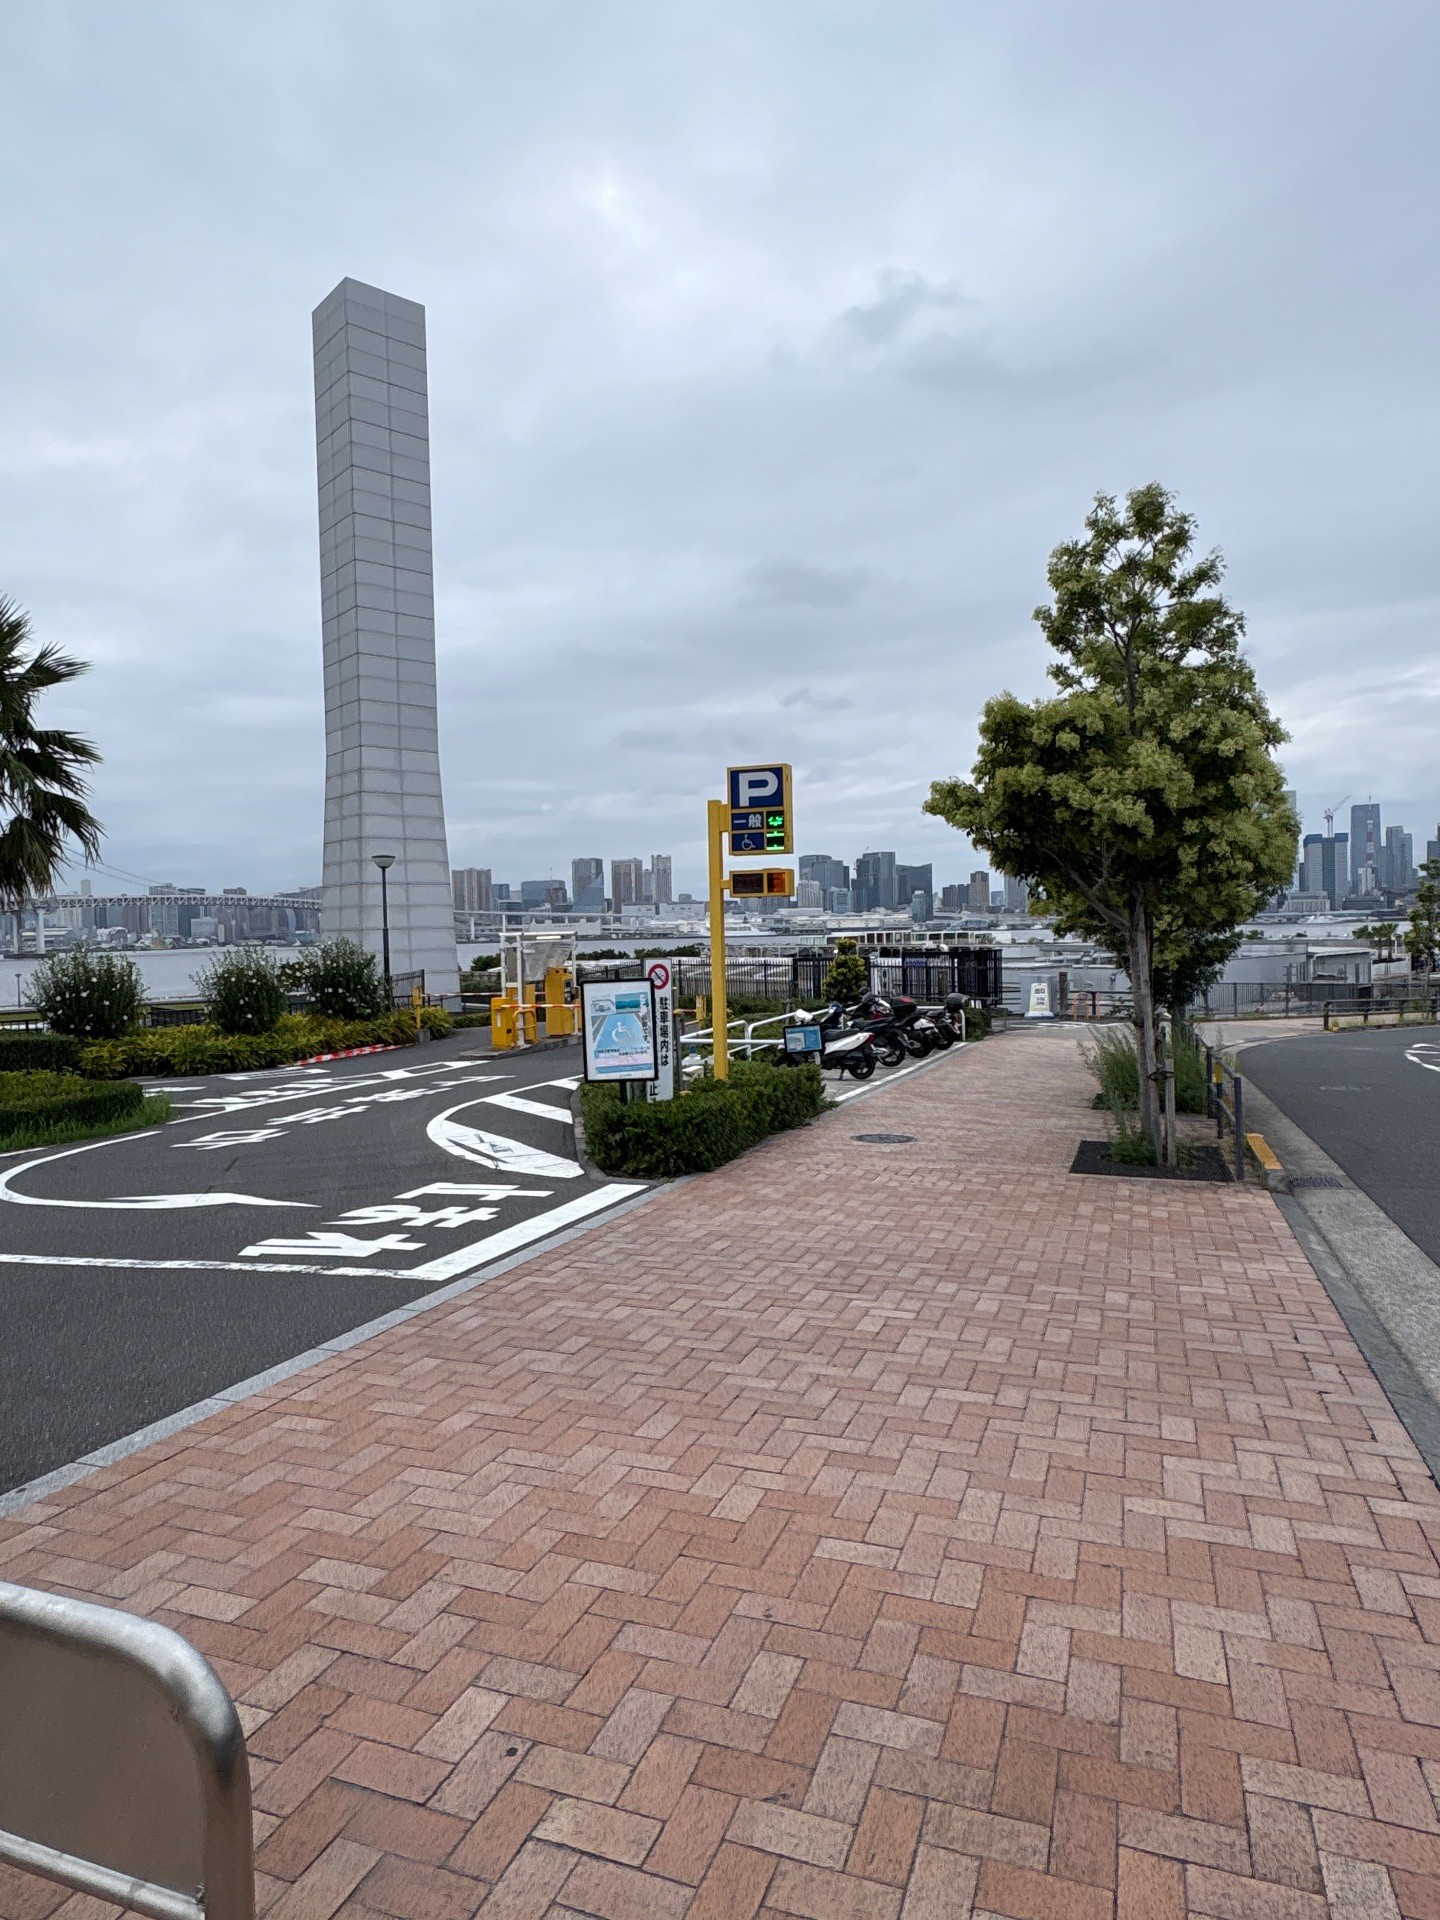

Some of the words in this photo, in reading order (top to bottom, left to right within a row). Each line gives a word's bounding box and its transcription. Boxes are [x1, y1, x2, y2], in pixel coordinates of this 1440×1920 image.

[739, 771, 778, 807] P
[733, 813, 762, 828] 一般
[659, 996, 669, 1066] 駐車場内は
[237, 1182, 555, 1257] 止まれ
